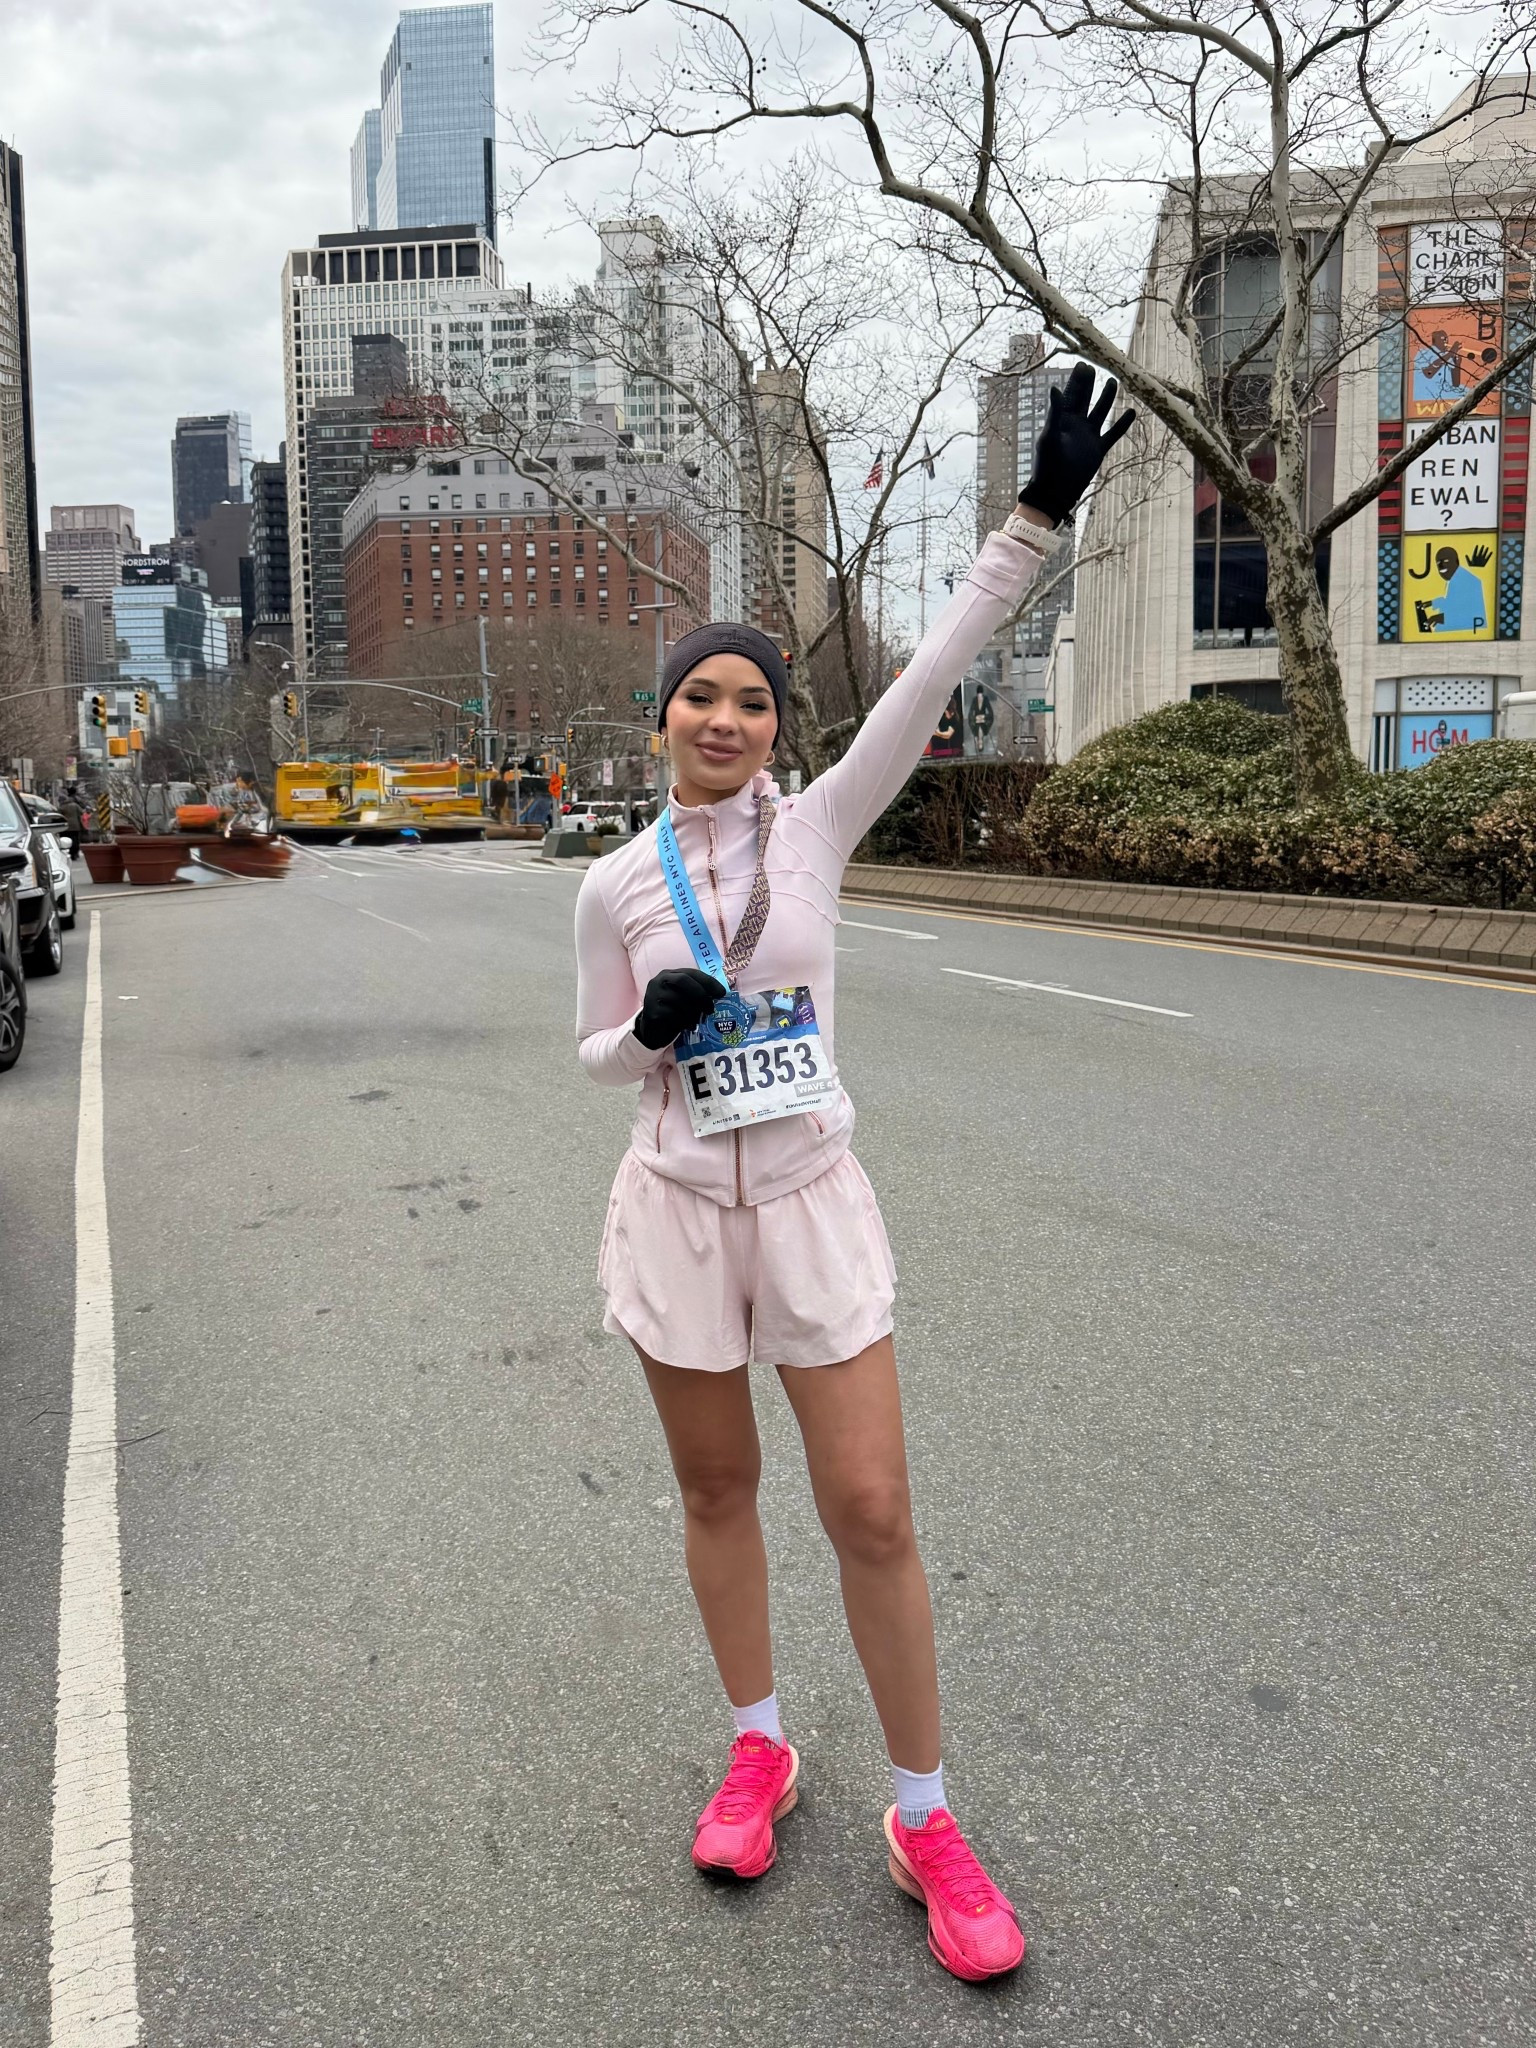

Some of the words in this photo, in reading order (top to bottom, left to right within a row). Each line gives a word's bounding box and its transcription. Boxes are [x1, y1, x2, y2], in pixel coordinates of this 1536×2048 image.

[1427, 228, 1478, 247] THE
[1416, 251, 1492, 270] CHARL
[1478, 312, 1496, 340] B
[1411, 425, 1496, 446] BAN
[1421, 458, 1478, 478] REN
[1411, 485, 1489, 506] EWAL
[1440, 509, 1453, 527] ?
[121, 558, 170, 567] NORDSTROM
[1473, 617, 1485, 634] P
[660, 826, 672, 852] HALF
[667, 855, 680, 879] NYC
[676, 882, 702, 936] AIRLINES
[698, 941, 718, 977] NITED
[688, 1062, 713, 1100] E
[715, 1042, 818, 1096] 31353
[797, 1081, 826, 1094] WAVE
